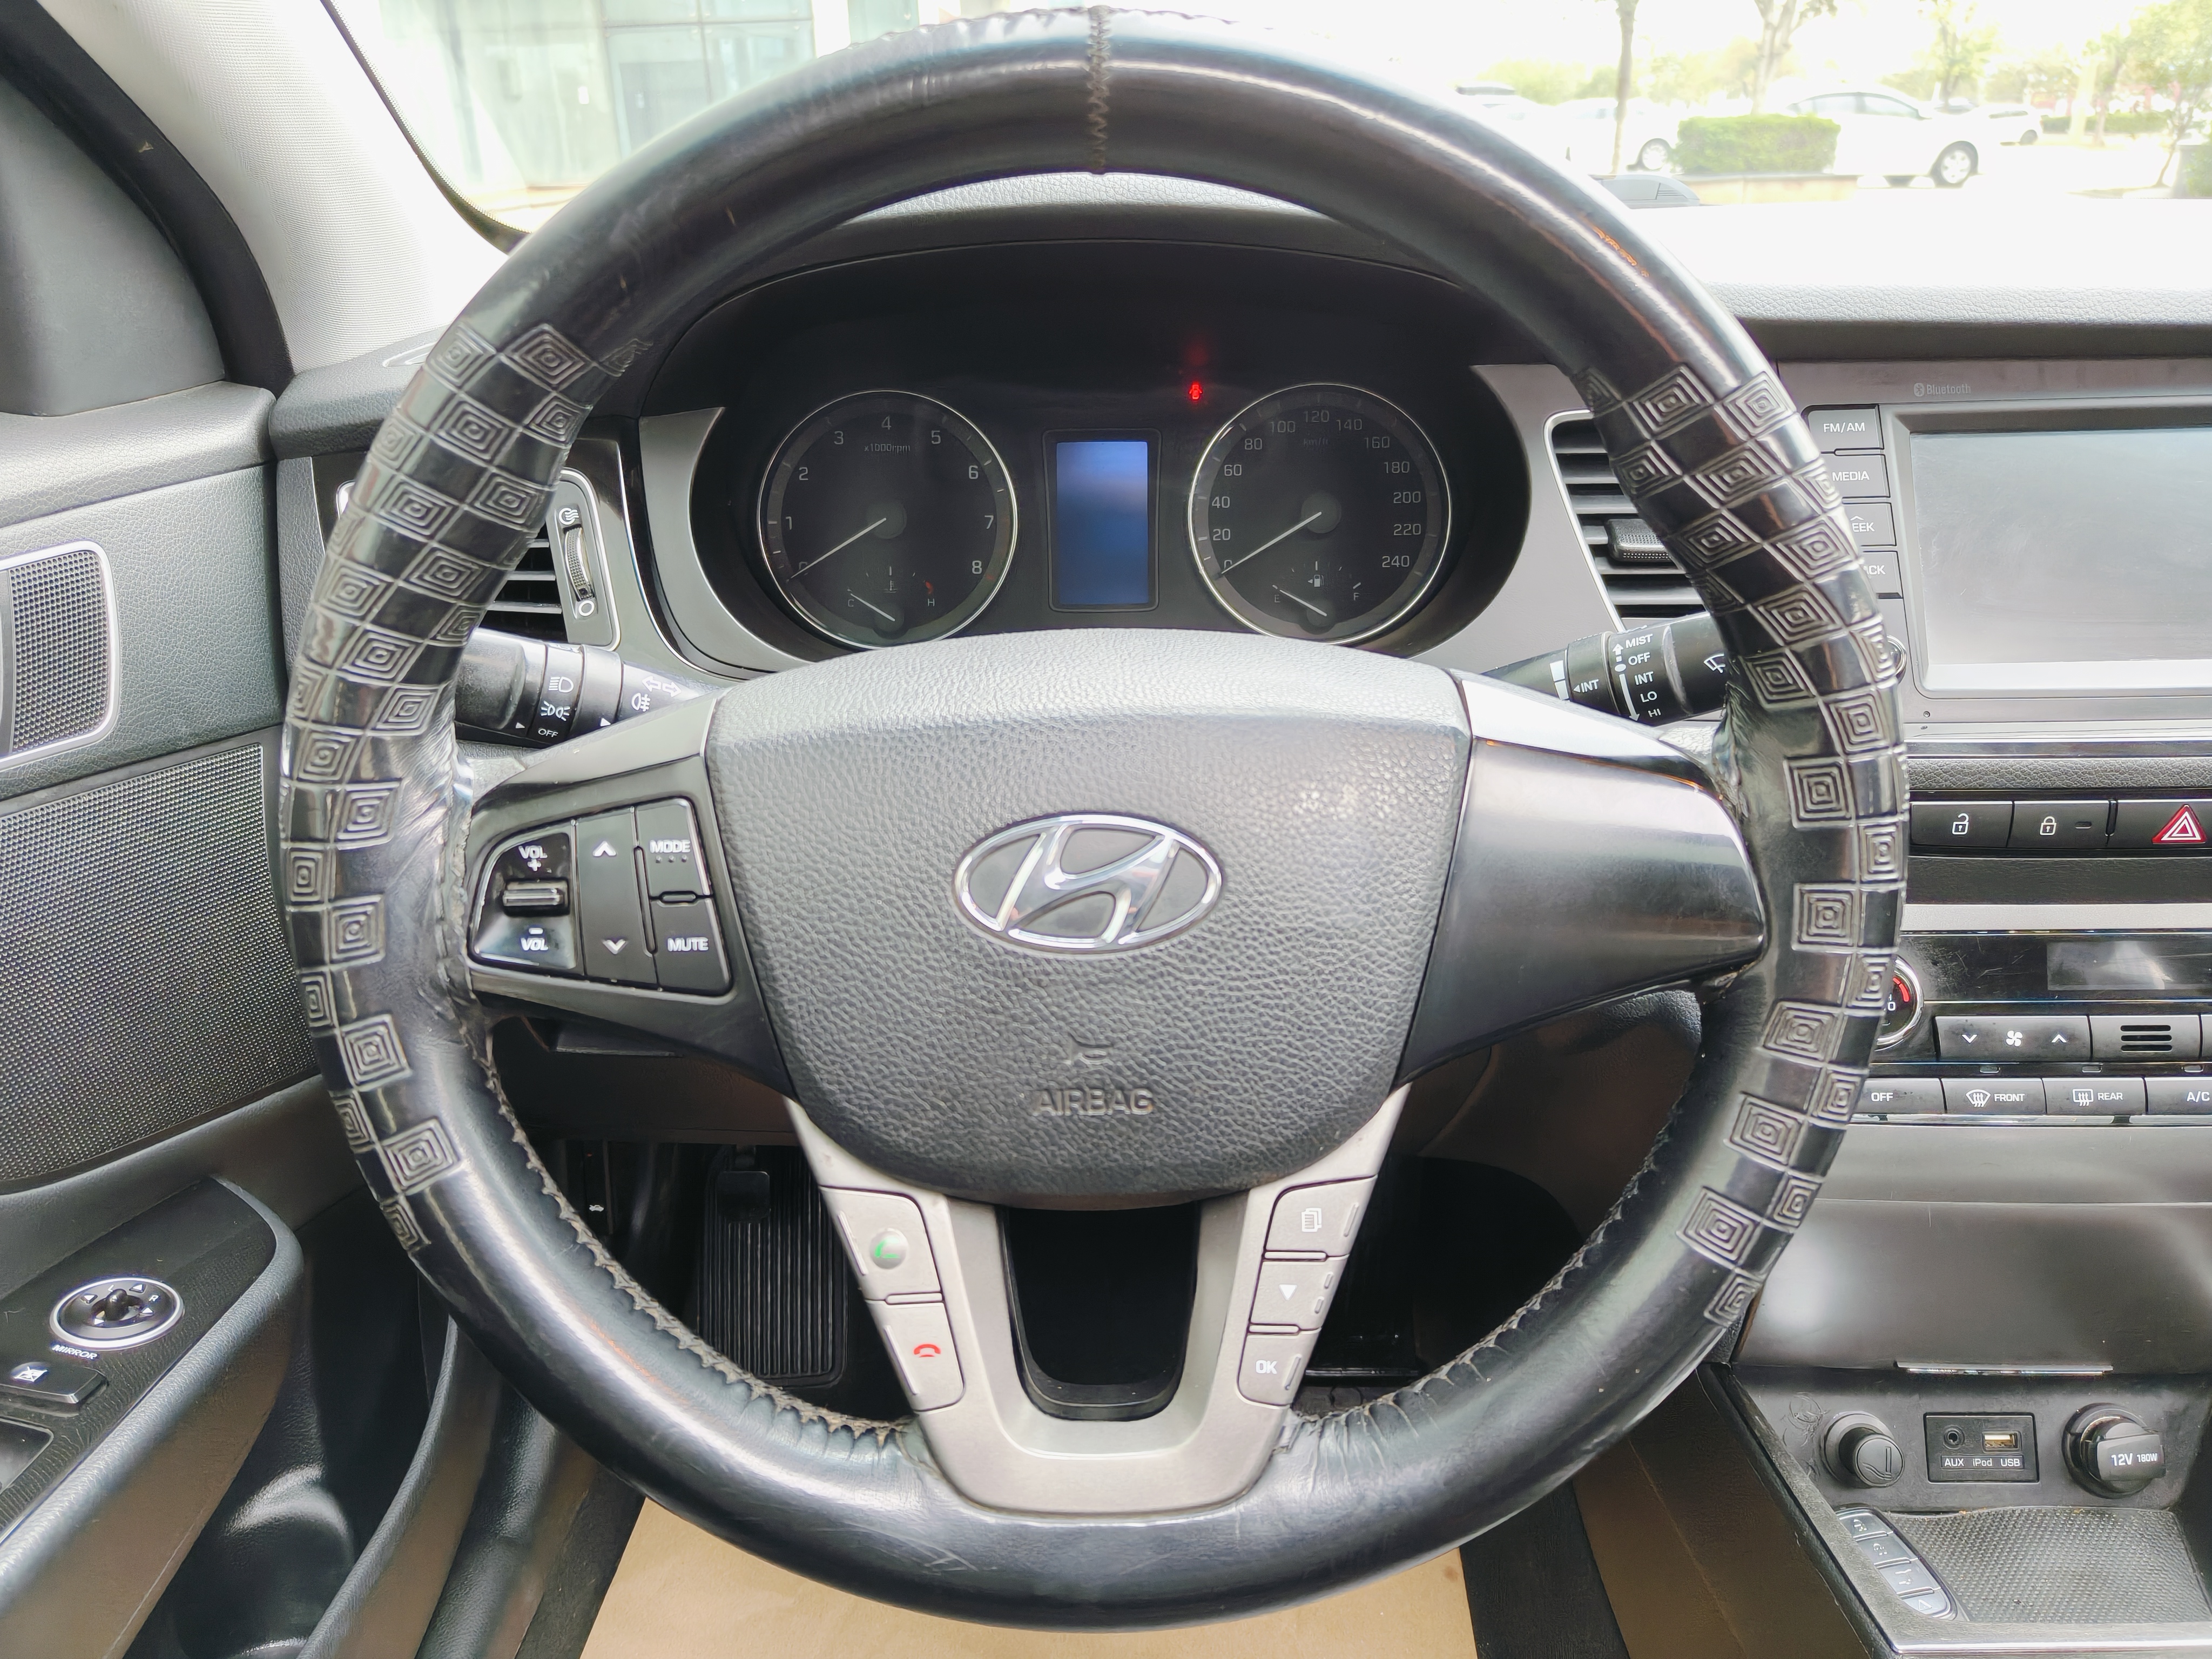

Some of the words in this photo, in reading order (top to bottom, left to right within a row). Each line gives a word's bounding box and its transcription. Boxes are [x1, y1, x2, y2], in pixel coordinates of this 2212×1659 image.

[1926, 383, 1971, 395] Bluetooth
[1303, 410, 1330, 422] 120
[881, 416, 892, 430] 4
[1270, 420, 1296, 433] 100
[1336, 419, 1363, 431] 140
[1823, 422, 1865, 433] FM/AM
[834, 431, 844, 445] 3
[930, 430, 941, 444] 5
[1364, 437, 1390, 449] 160
[1244, 438, 1263, 450] 80
[798, 467, 809, 481] 2
[968, 466, 979, 480] 6
[1224, 464, 1242, 477] 60
[1383, 461, 1410, 474] 180
[1832, 470, 1870, 482] MEDIA
[1211, 496, 1230, 509] 40
[1393, 491, 1421, 504] 200
[785, 516, 792, 530] 1
[984, 515, 994, 529] 7
[1852, 522, 1875, 532] EEK
[1212, 528, 1231, 541] 20
[1393, 523, 1421, 536] 220
[971, 560, 982, 574] 8
[1381, 555, 1410, 568] 240
[847, 599, 854, 607] C
[927, 598, 935, 606] H
[1274, 595, 1280, 603] E
[1354, 592, 1359, 601] F
[1625, 633, 1654, 649] MIST
[1628, 652, 1650, 666] OFF
[1634, 671, 1654, 685] INT
[1580, 679, 1600, 693] INT
[1640, 691, 1657, 703] LO
[1648, 708, 1661, 718] HI
[538, 728, 558, 738] OFF
[518, 845, 548, 859] VOL
[650, 839, 691, 853] MODE
[521, 937, 549, 951] VOL
[667, 937, 709, 952] MUTE
[1031, 1088, 1155, 1116] AIRBAG
[1871, 1092, 1893, 1102] OFF
[1994, 1092, 2025, 1103] FRONT
[2097, 1092, 2123, 1102] REAR
[2187, 1091, 2211, 1102] A/C
[52, 1345, 97, 1359] MIRROR
[1256, 1359, 1278, 1374] OK
[1945, 1458, 1965, 1467] AUX
[1972, 1457, 1993, 1467] iPod
[2000, 1458, 2021, 1467] USB
[2111, 1453, 2134, 1467] 12V
[2137, 1453, 2158, 1464] 180W
